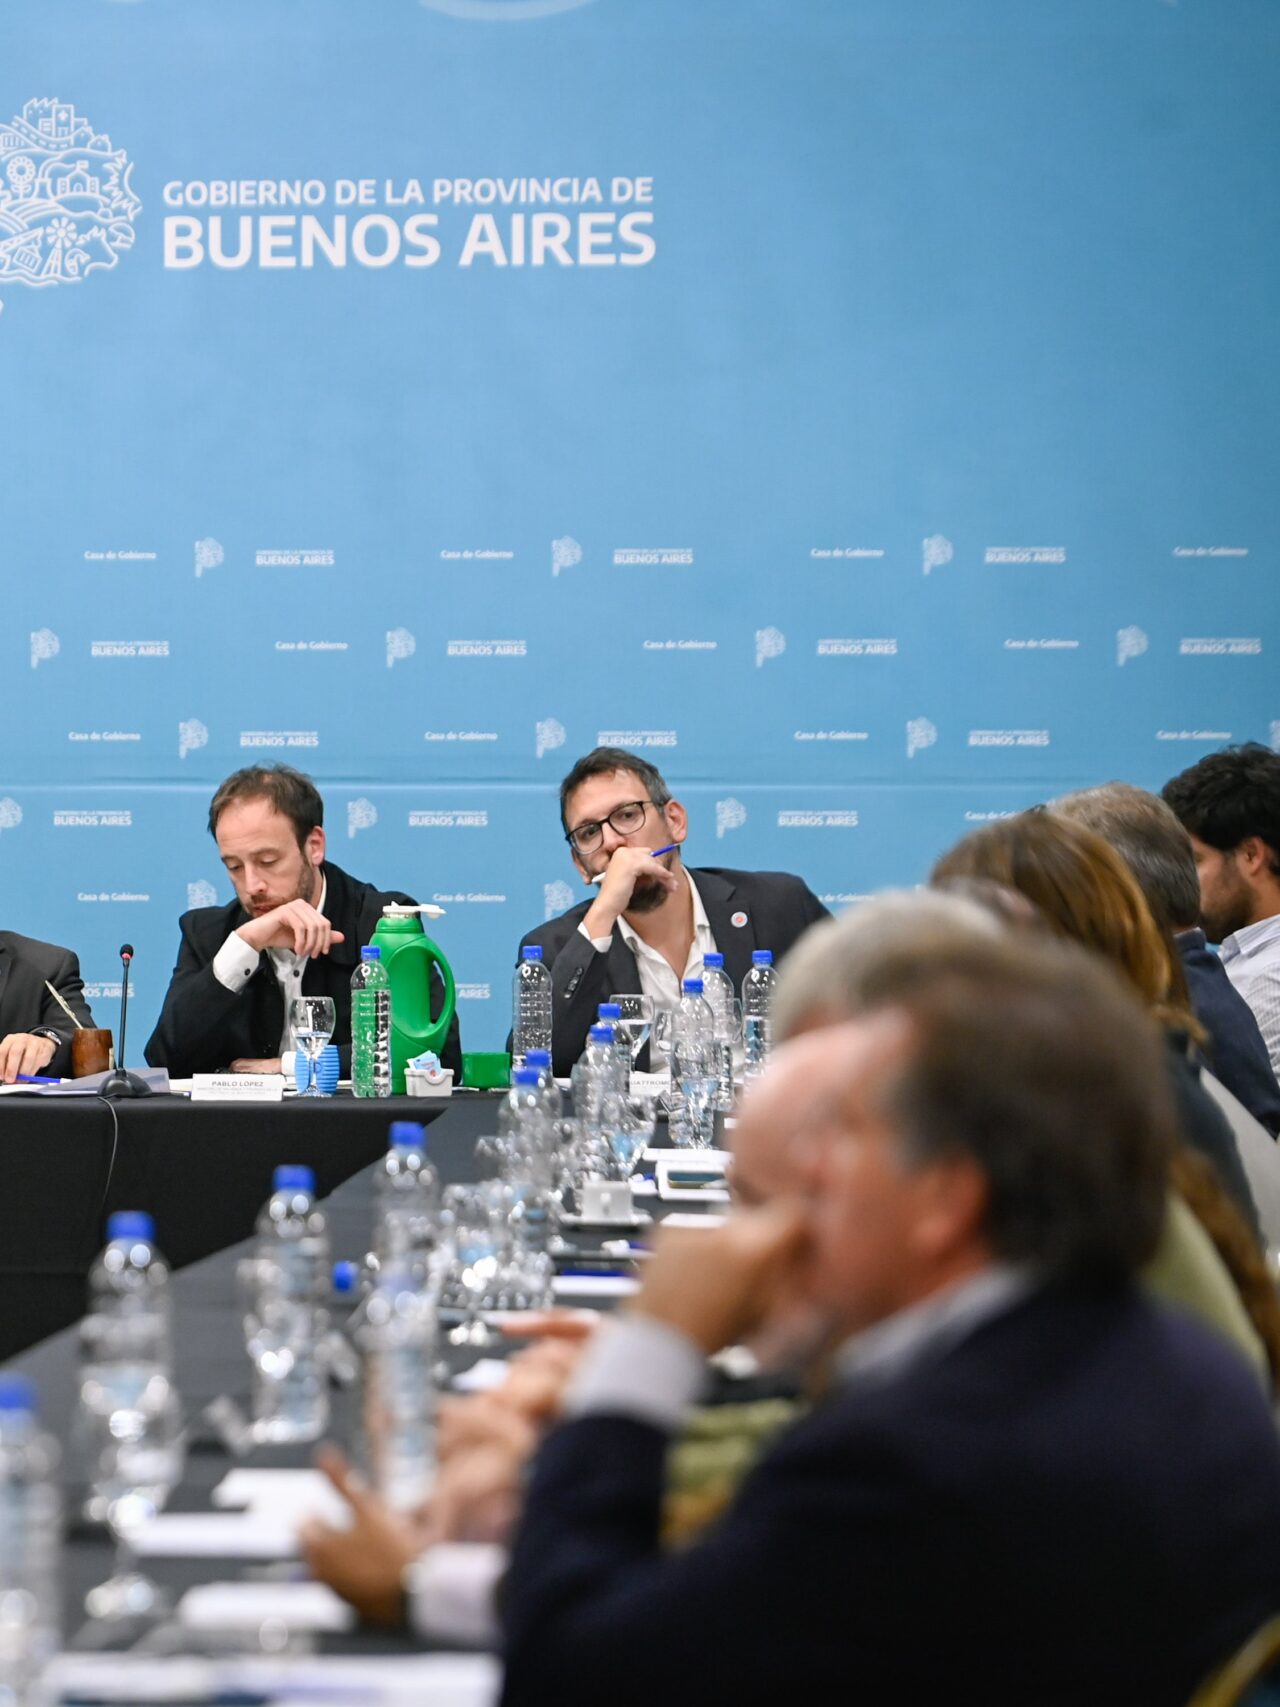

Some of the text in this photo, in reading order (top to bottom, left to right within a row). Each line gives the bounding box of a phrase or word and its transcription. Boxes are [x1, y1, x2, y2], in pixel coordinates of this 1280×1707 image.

[163, 178, 652, 206] GOBIERNO DE LA PROVINCIA DE
[163, 213, 656, 269] BUENOS AIRES
[106, 551, 116, 559] de
[255, 554, 334, 565] BUENOS AIRES
[613, 553, 693, 564] BUENOS AIRES
[91, 645, 169, 656] BUENOS AIRES
[447, 645, 526, 655] BUENOS AIRES
[90, 731, 100, 740] de
[597, 735, 677, 746] BUENOS AIRES
[240, 736, 319, 746] BUENOS AIRES
[53, 815, 131, 825] BUENOS AIRES
[408, 816, 487, 825] BUENOS AIRES
[777, 816, 857, 825] BUENOS AIRES
